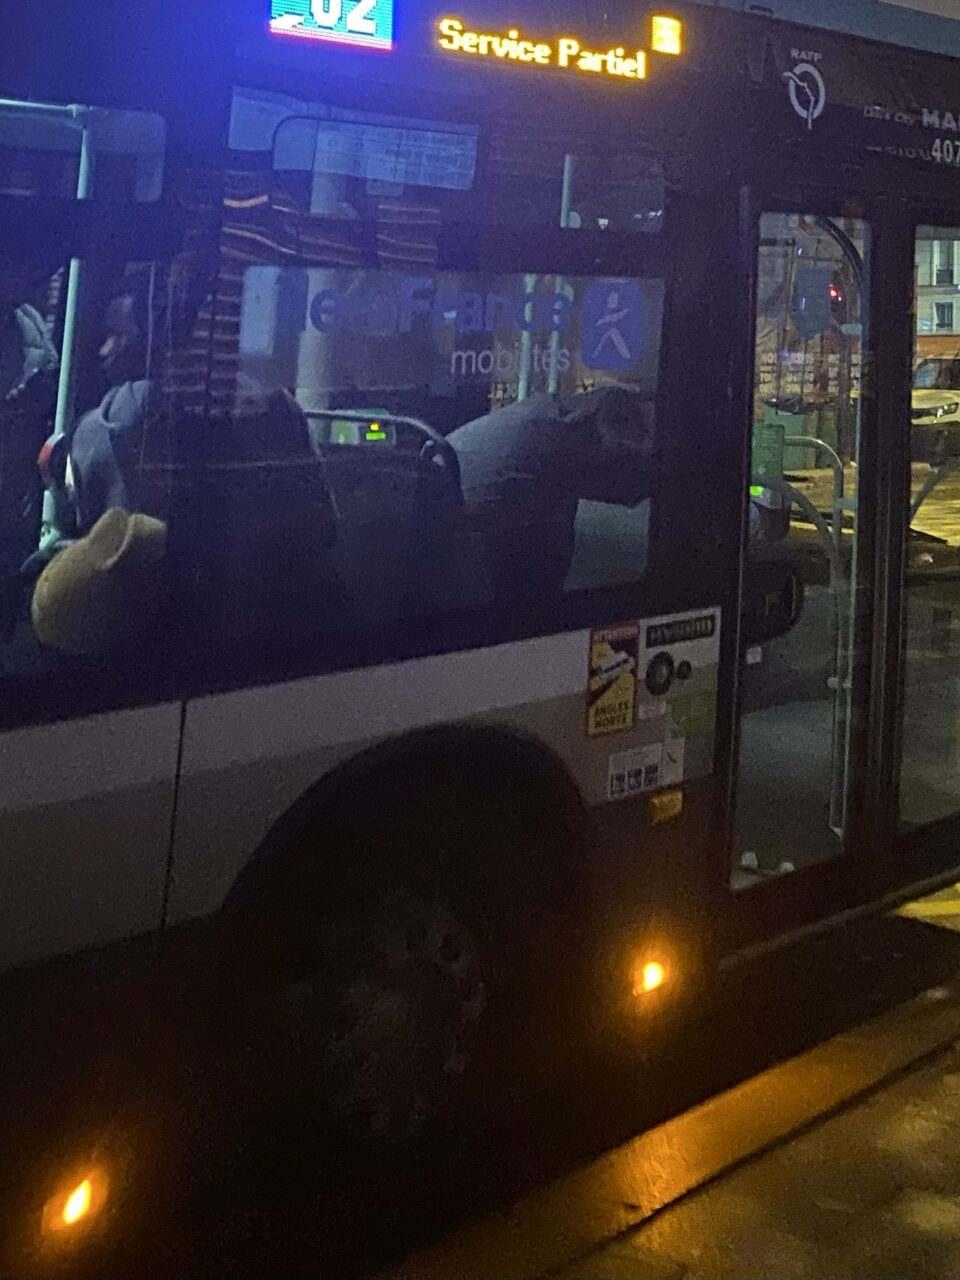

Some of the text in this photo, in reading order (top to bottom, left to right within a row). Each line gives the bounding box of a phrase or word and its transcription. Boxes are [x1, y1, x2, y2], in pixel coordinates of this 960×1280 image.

[439, 19, 645, 79] Service Partiel
[790, 47, 822, 61] RATP
[450, 341, 571, 376] mobits
